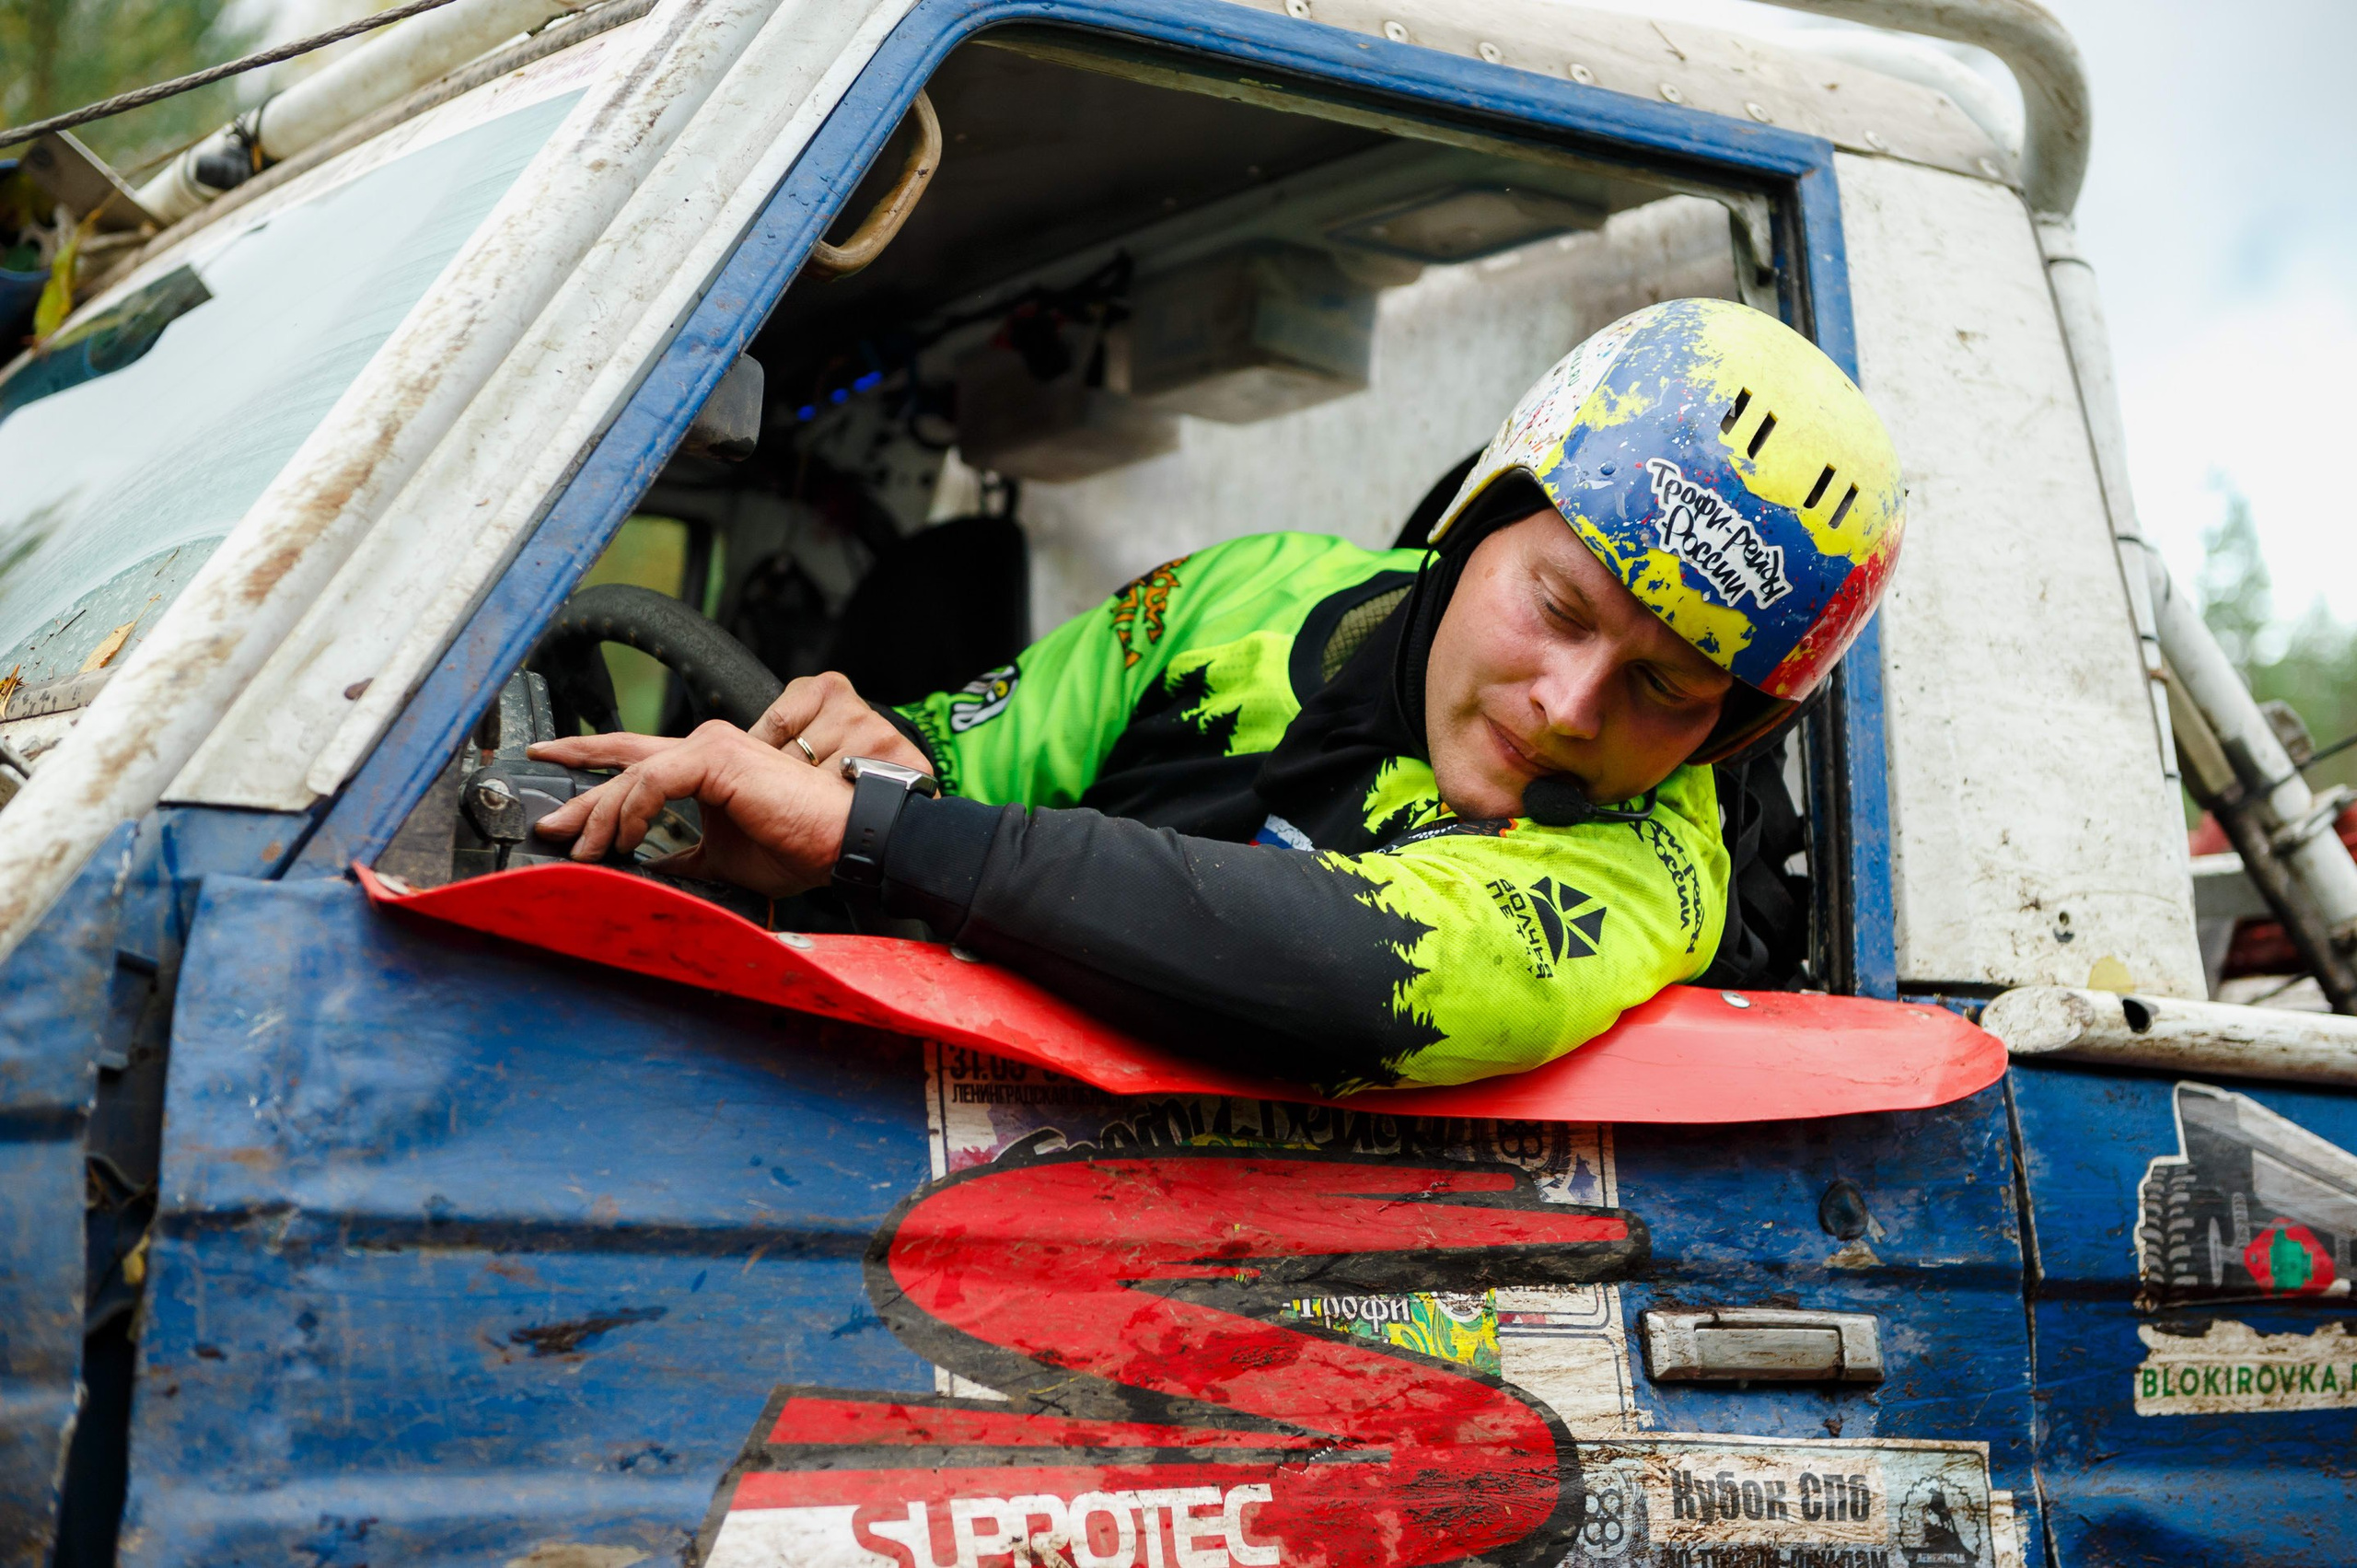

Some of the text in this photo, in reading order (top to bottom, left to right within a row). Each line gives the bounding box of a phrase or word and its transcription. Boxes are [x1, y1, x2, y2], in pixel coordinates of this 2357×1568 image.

[1652, 461, 1786, 603] Трофи-рейды
[1662, 505, 1747, 602] России
[852, 1483, 1282, 1568] SUPROTEC
[1671, 1469, 1871, 1524] Кубок СПб
